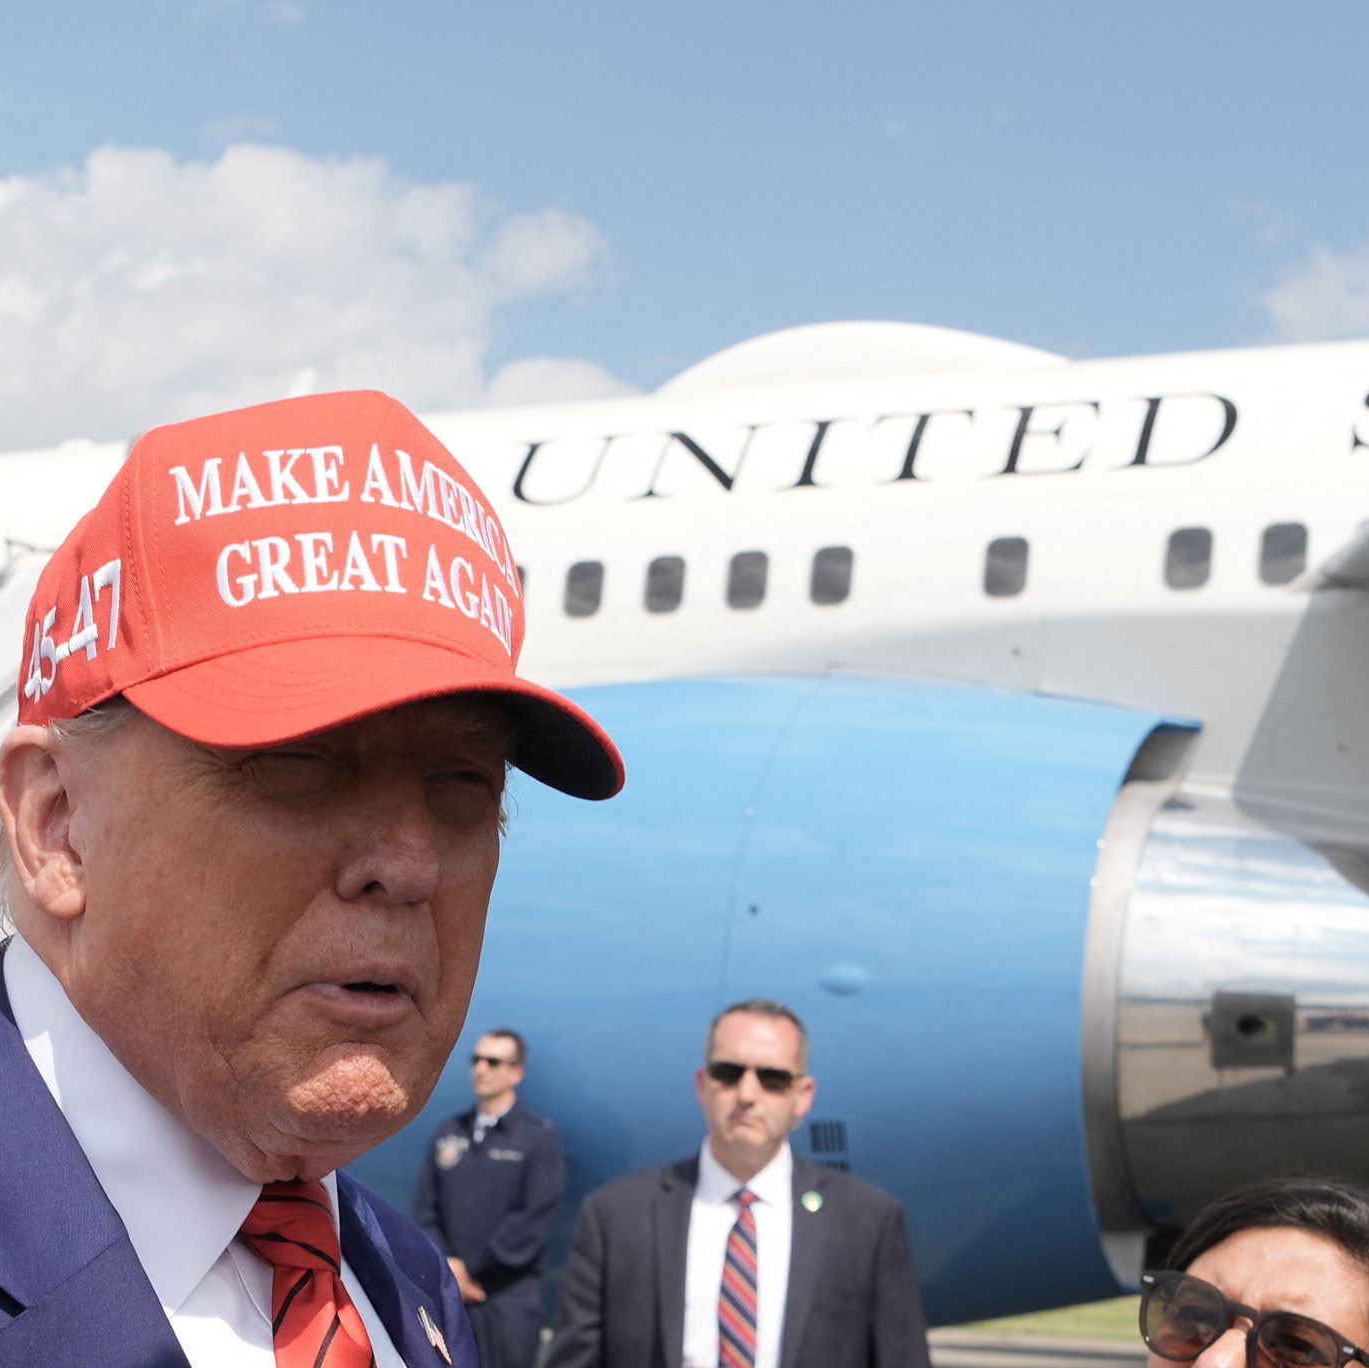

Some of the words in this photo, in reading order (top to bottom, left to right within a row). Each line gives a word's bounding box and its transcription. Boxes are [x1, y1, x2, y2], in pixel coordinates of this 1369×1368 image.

[511, 390, 1239, 506] UNITED
[169, 445, 350, 526] MAKE
[359, 442, 519, 600] AMERICA
[23, 557, 122, 706] 45-47
[215, 530, 408, 608] GREAT
[422, 543, 513, 658] AGAIN
